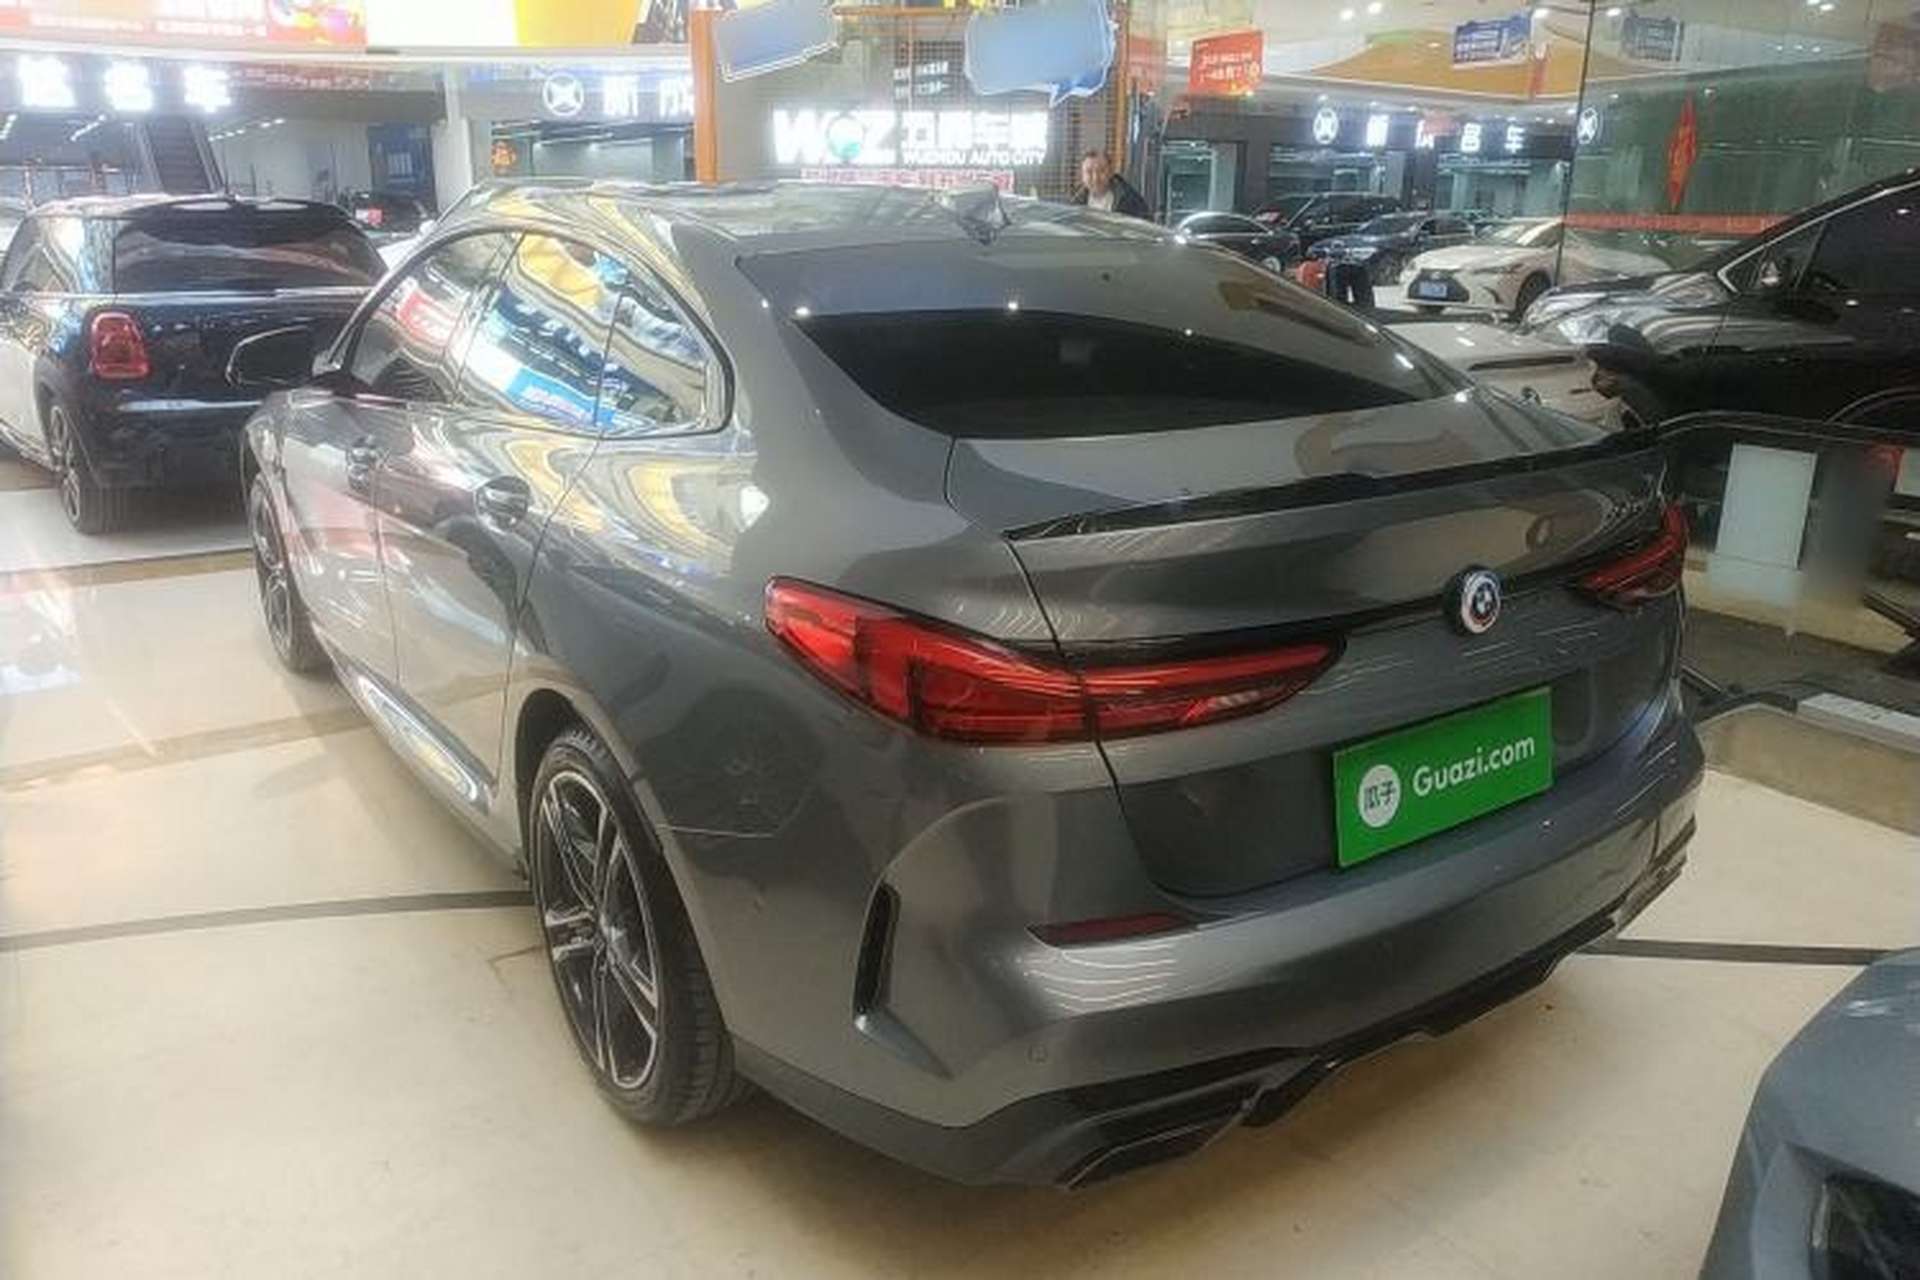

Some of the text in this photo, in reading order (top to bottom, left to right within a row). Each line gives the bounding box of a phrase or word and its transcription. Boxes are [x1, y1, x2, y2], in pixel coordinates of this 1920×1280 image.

[969, 150, 1009, 165] AUTO
[1011, 150, 1046, 165] CITY
[1412, 736, 1536, 797] Guazi.com
